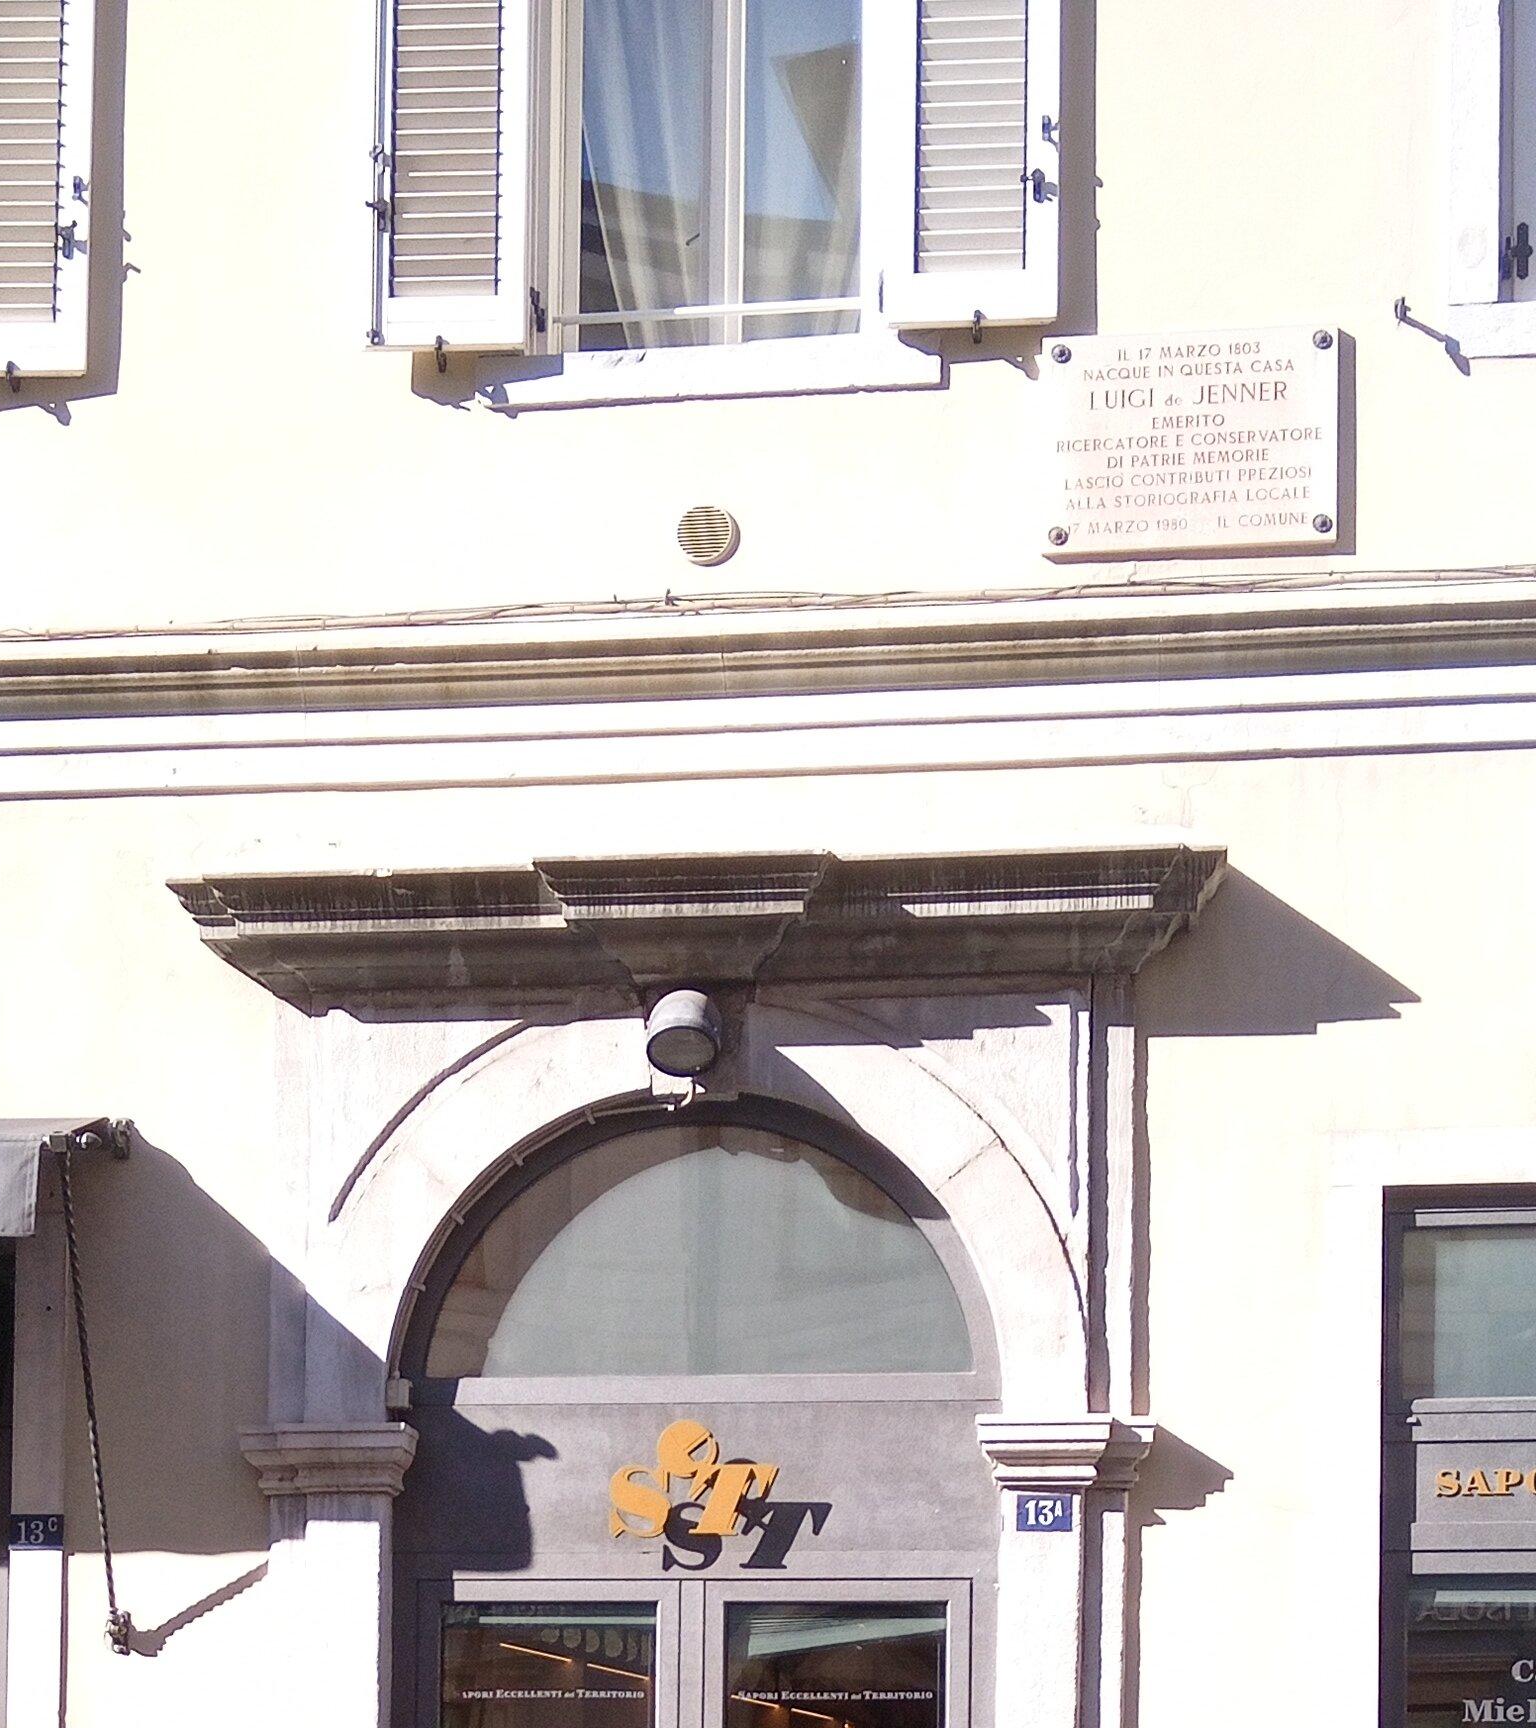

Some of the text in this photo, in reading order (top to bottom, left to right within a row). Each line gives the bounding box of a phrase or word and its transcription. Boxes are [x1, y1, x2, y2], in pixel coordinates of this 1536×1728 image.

[1117, 341, 1261, 362] IL 17 MARZO 1803
[1083, 358, 1295, 381] NACQUE IN QUESTA CASA
[1089, 387, 1155, 411] LUIGI
[1192, 380, 1289, 406] JENNER
[1151, 413, 1226, 430] EMERITO
[1056, 427, 1323, 453] RICERCATORE E CONSERVATORE
[1107, 448, 1270, 469] DI PATRIE MEMORIE
[1130, 469, 1232, 487] CONTRIBUTI
[1238, 466, 1312, 483] PREZIOSI
[1065, 486, 1311, 511] ALLA STORIOGRAFIA LOCALE
[1088, 519, 1149, 535] MARZO
[1217, 516, 1230, 529] IL
[1238, 512, 1309, 528] COMUNE
[457, 1689, 494, 1699] APORI
[496, 1689, 563, 1699] ECCELLENTI
[576, 1688, 645, 1699] TERRITORIO
[781, 1690, 849, 1700] ECCELLENTI
[863, 1690, 933, 1700] TERRITORIO
